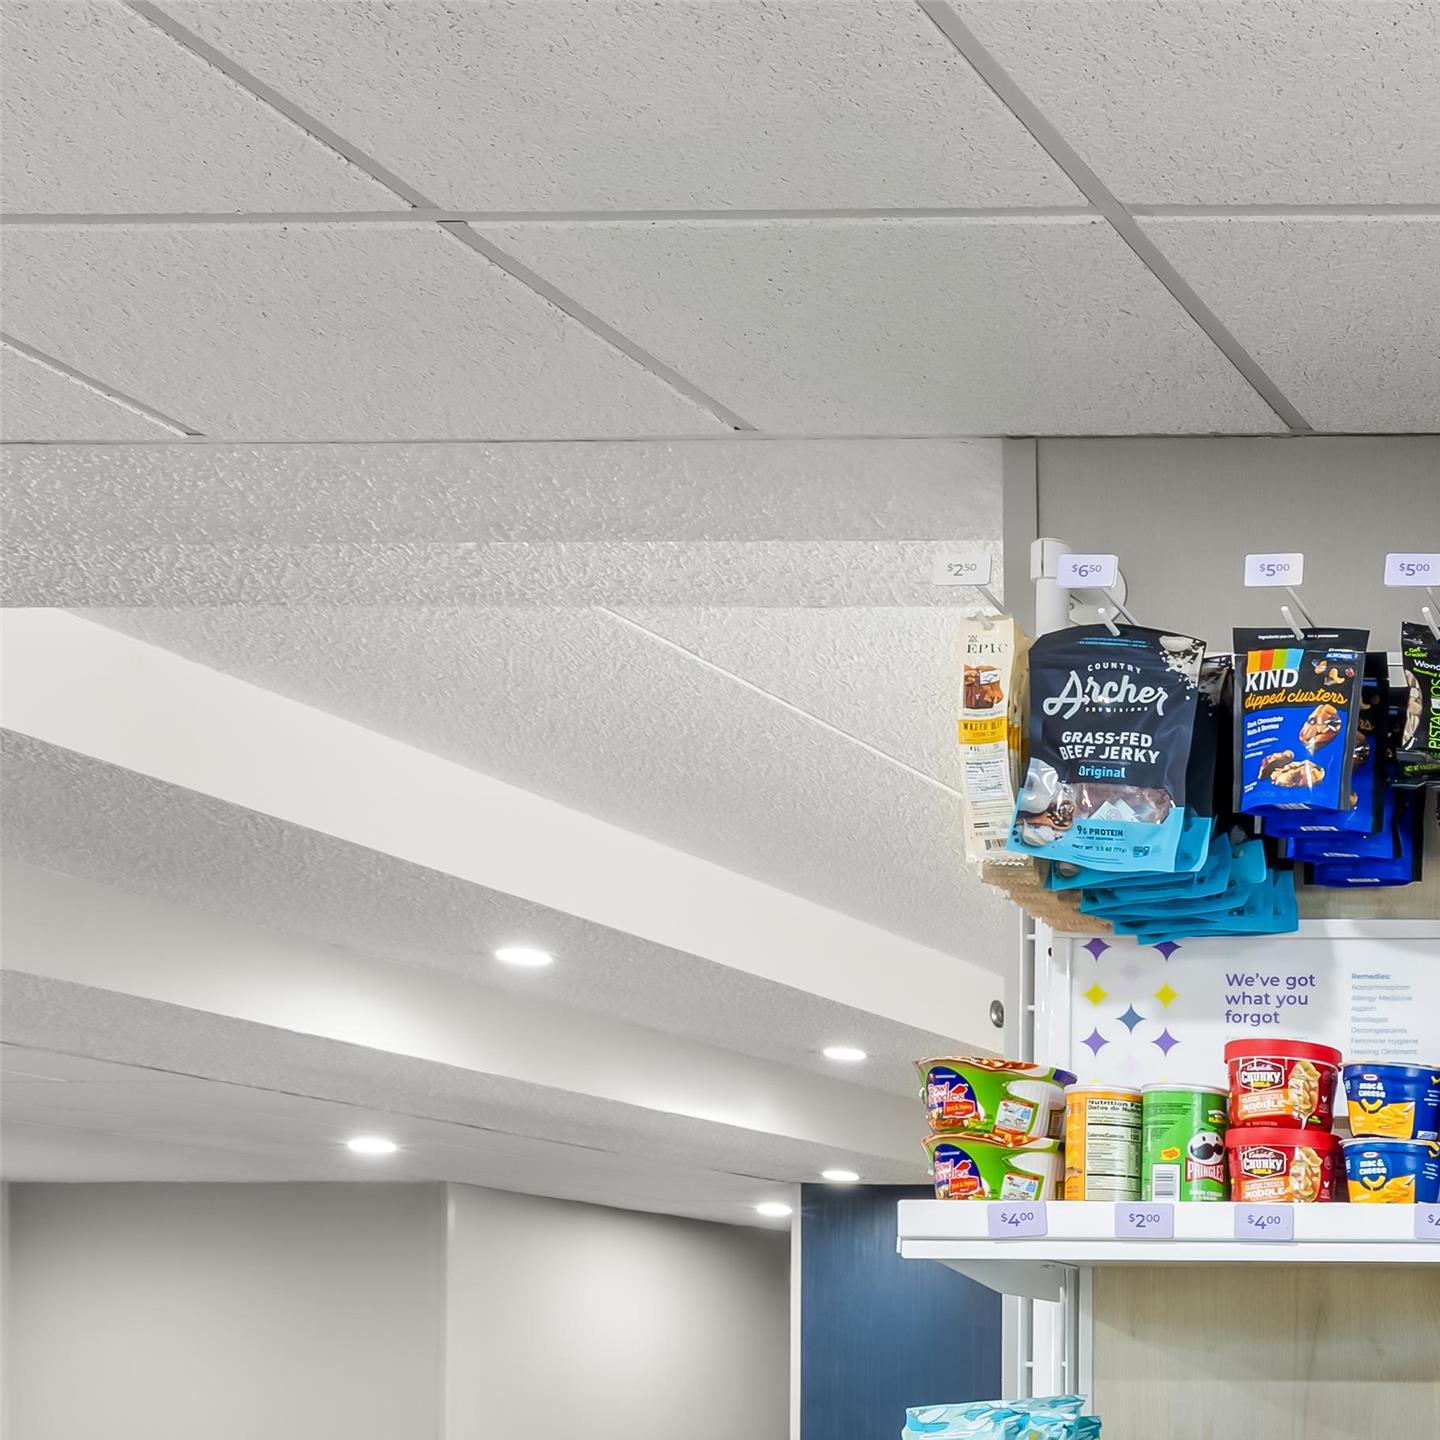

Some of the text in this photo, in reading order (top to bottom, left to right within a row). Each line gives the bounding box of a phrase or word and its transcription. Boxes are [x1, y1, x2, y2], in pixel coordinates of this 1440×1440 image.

[1088, 662, 1142, 674] COUNTRY
[1245, 668, 1299, 693] KIND
[1043, 670, 1168, 720] Archer
[1245, 689, 1348, 709] dipped clusters
[1061, 732, 1152, 747] GRASS-FED
[1060, 746, 1160, 764] BEEF JERKY
[1078, 765, 1126, 779] Original
[1226, 973, 1316, 989] We've got
[1226, 992, 1308, 1008] what you
[1225, 1010, 1280, 1026] forgot
[1241, 1071, 1280, 1083] CHUNKY
